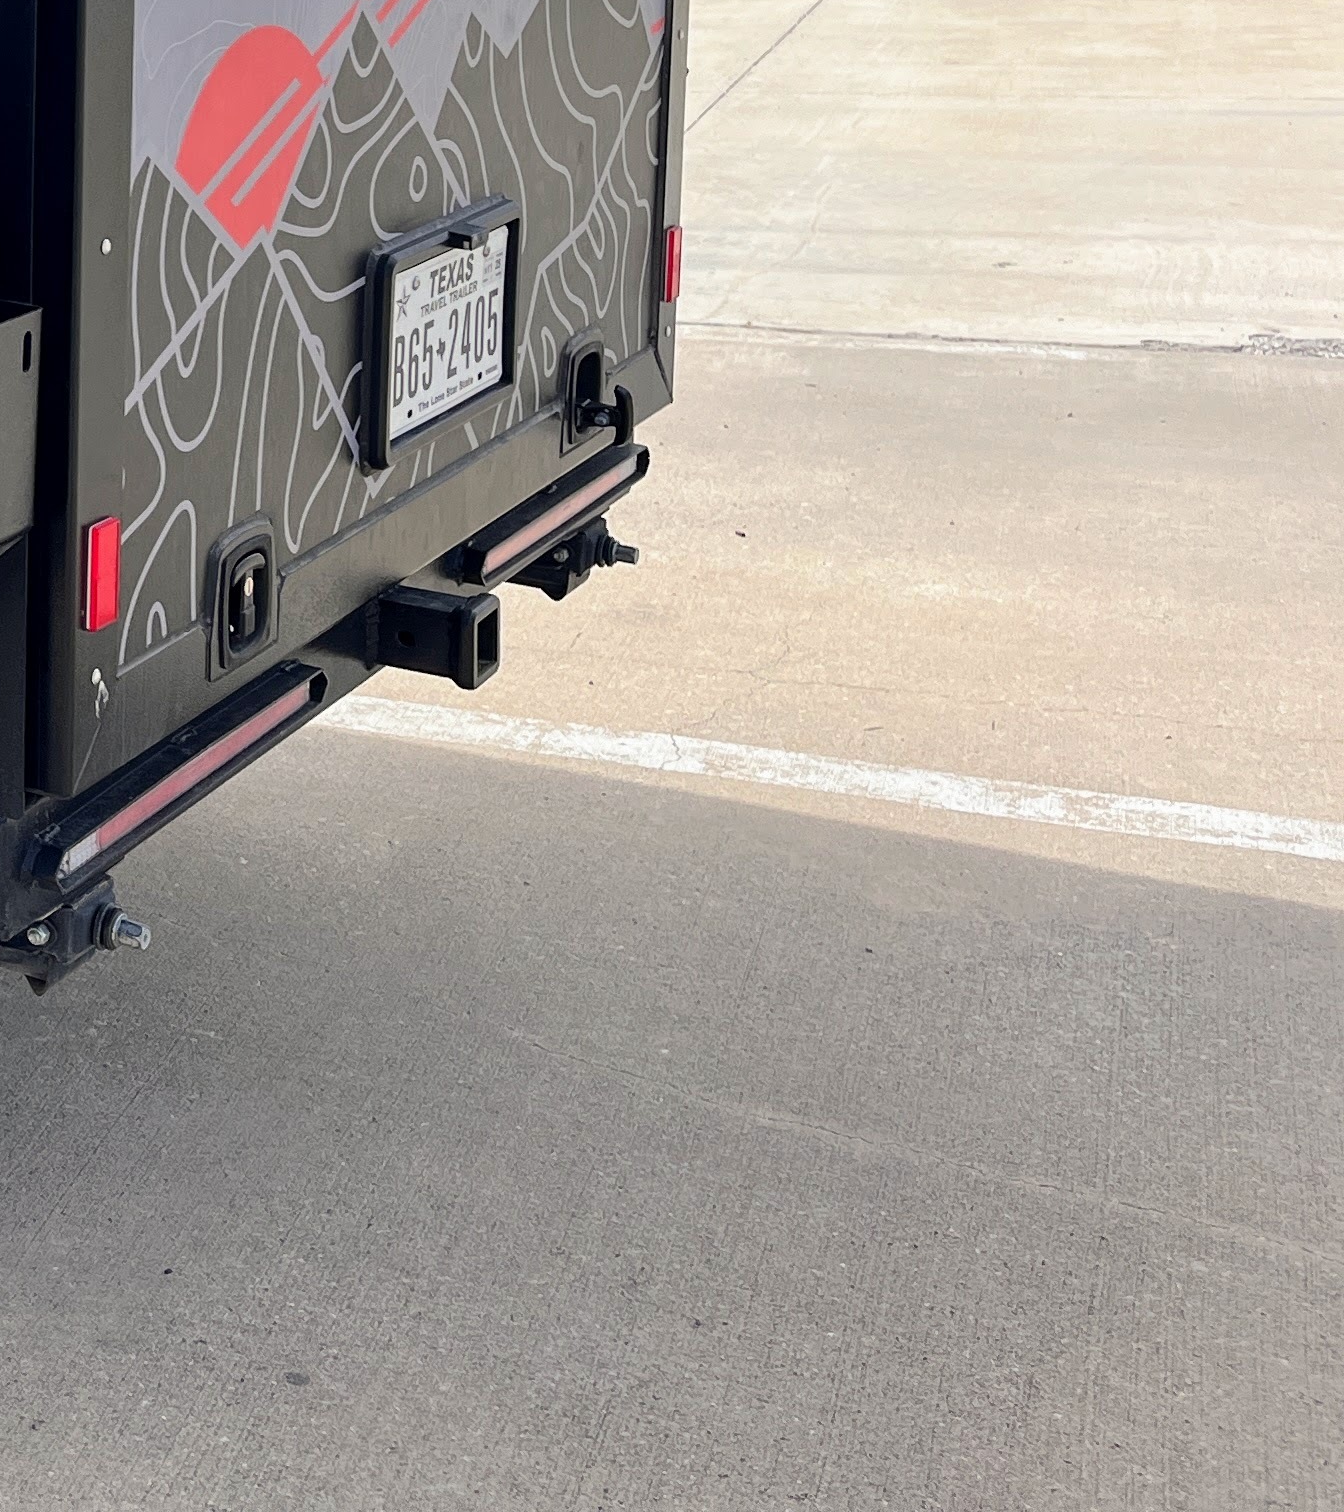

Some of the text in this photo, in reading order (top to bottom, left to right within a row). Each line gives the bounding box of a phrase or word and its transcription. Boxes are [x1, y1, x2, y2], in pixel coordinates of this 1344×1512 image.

[430, 253, 475, 298] TEXAS
[420, 280, 478, 317] TRAVEL TRAILER
[418, 400, 429, 412] The
